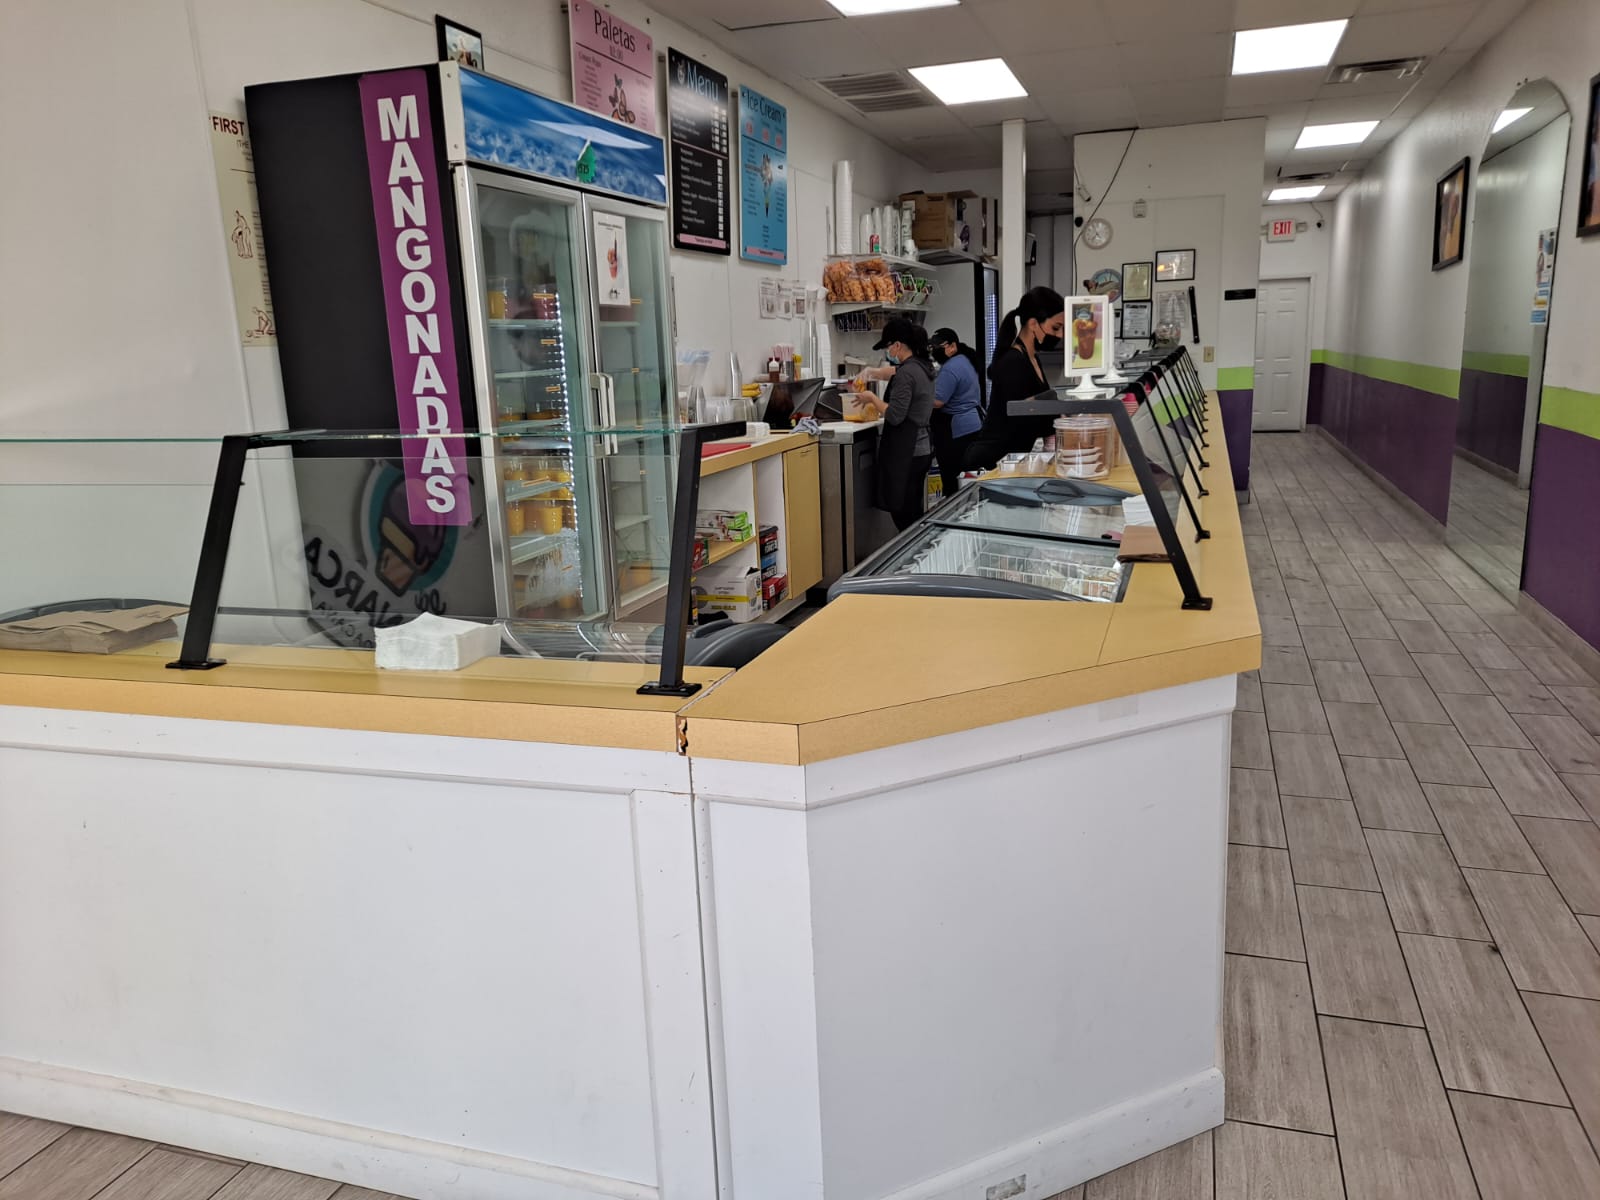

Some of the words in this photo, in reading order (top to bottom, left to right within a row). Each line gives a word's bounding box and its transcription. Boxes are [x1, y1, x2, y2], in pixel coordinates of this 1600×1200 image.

[594, 9, 636, 52] Paletas
[686, 60, 720, 102] Menu
[746, 90, 759, 113] Ice
[759, 96, 783, 122] Cream
[1273, 220, 1293, 236] EXIT
[376, 94, 457, 514] MANGONADAS
